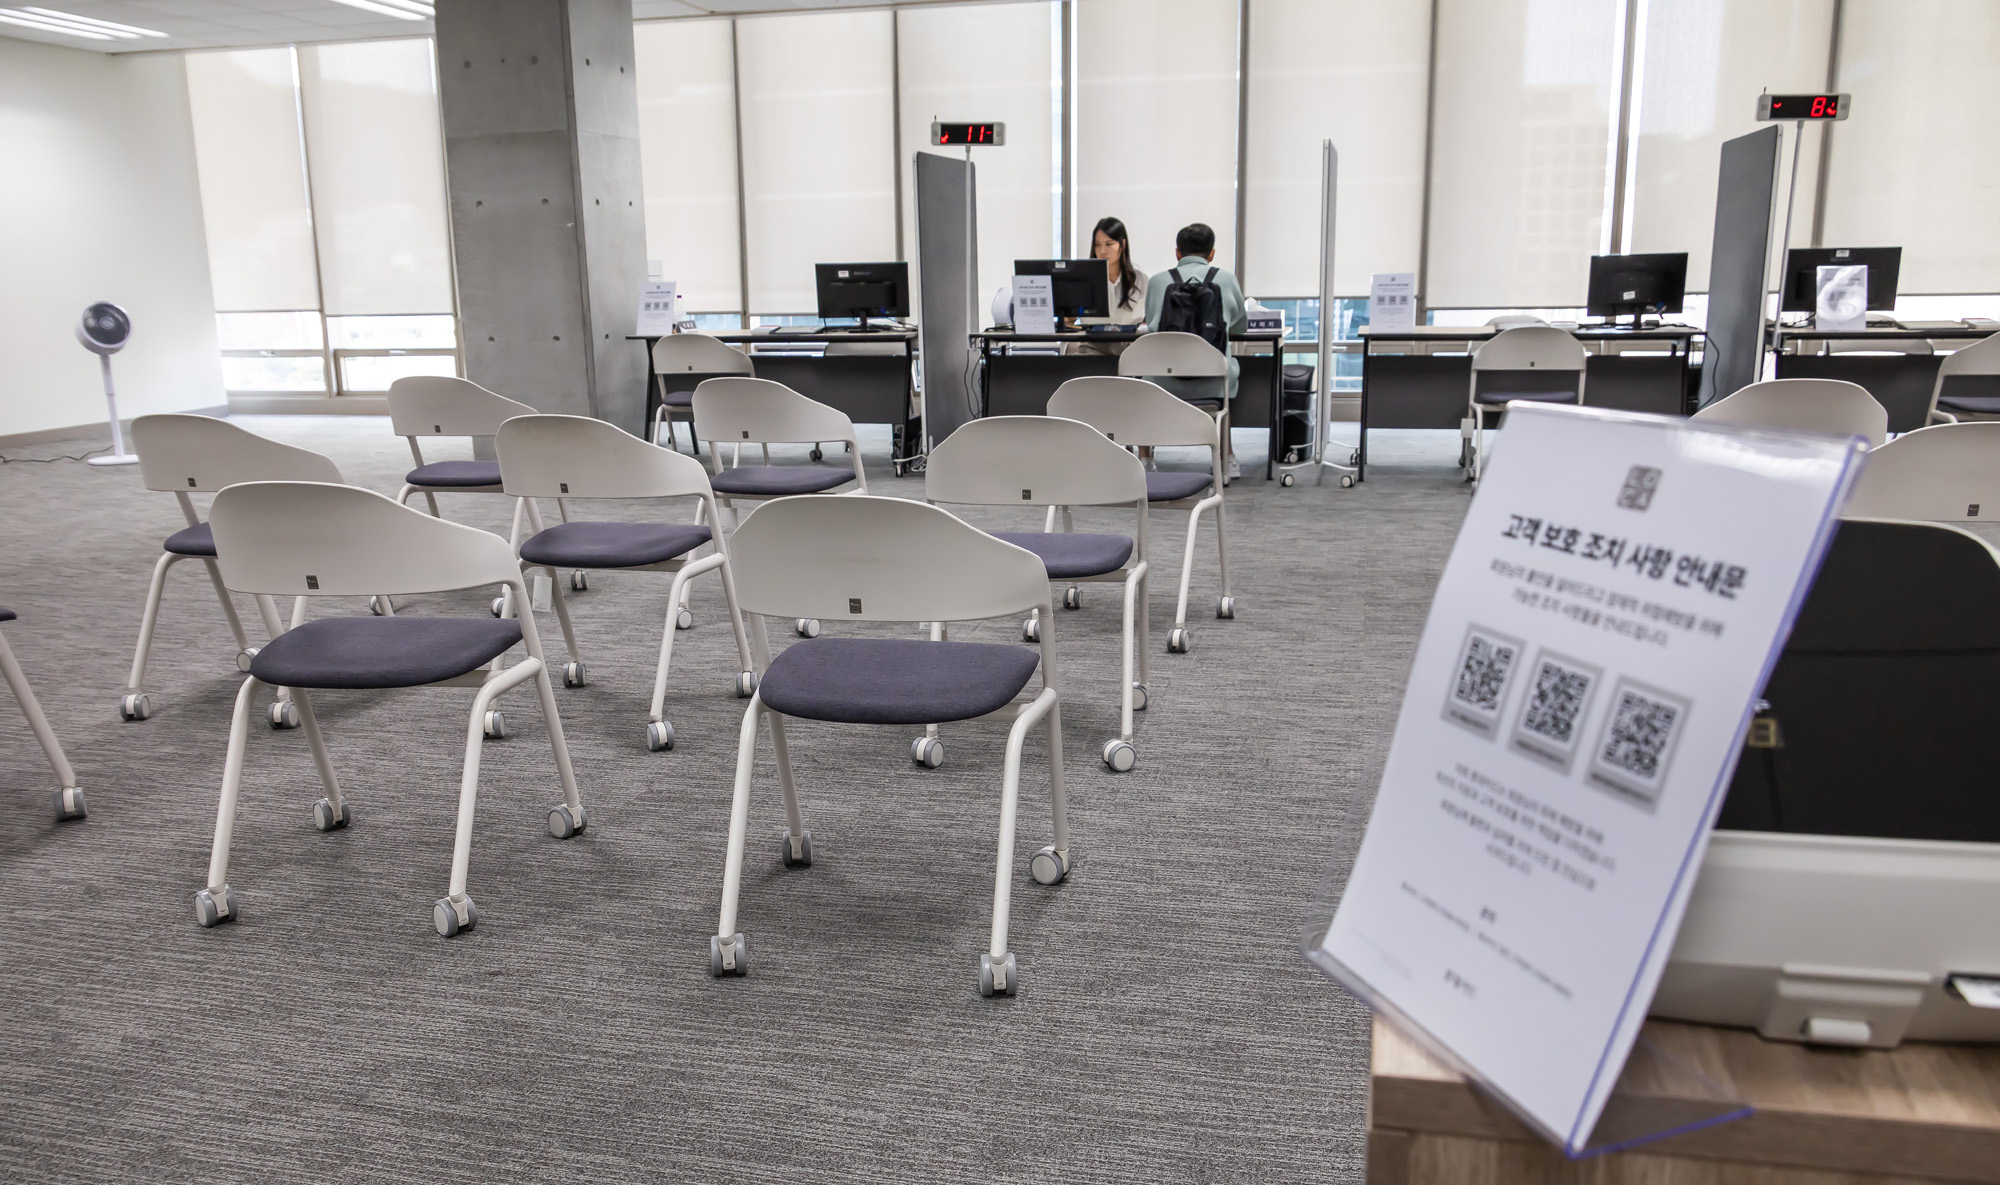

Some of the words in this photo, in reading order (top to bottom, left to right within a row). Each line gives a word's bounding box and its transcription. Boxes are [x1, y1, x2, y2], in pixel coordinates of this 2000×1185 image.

[1810, 97, 1827, 117] 8
[1502, 514, 1542, 545] 고객
[1540, 523, 1583, 555] 보호
[1581, 532, 1627, 568] 조치
[1626, 544, 1673, 580] 사항
[1674, 555, 1747, 599] 안내문
